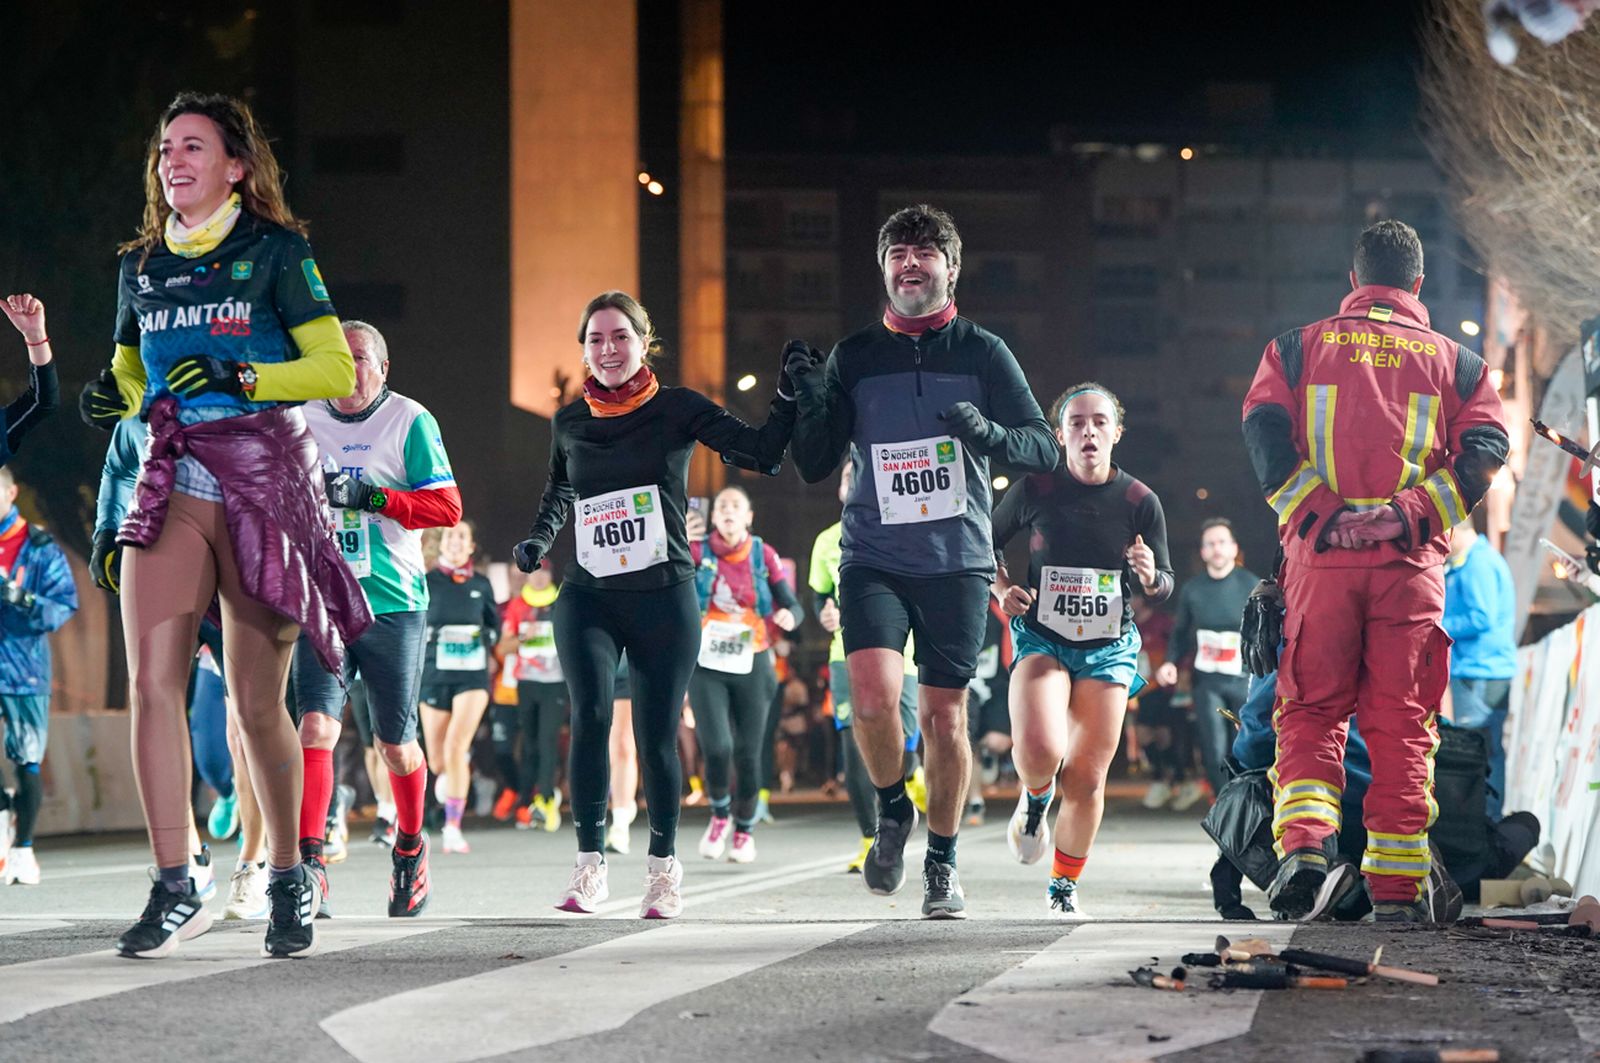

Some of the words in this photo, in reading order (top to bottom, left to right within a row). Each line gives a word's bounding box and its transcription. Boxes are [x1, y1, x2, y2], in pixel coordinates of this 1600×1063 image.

[172, 296, 251, 329] ANTÓN
[210, 316, 251, 336] 2025
[1322, 331, 1437, 356] BOMBEROS
[1349, 348, 1402, 369] JAÉN
[891, 450, 917, 460] NOCHE
[918, 449, 929, 458] DE
[883, 462, 899, 471] SAN
[892, 466, 951, 496] 4606
[592, 501, 615, 513] NOCHE
[615, 499, 626, 509] DE
[583, 515, 599, 526] SAN
[593, 517, 646, 548] 4607
[1049, 583, 1065, 593] SAN
[1060, 575, 1083, 584] NOCHE
[1084, 576, 1093, 584] DE
[1053, 594, 1108, 617] 4556
